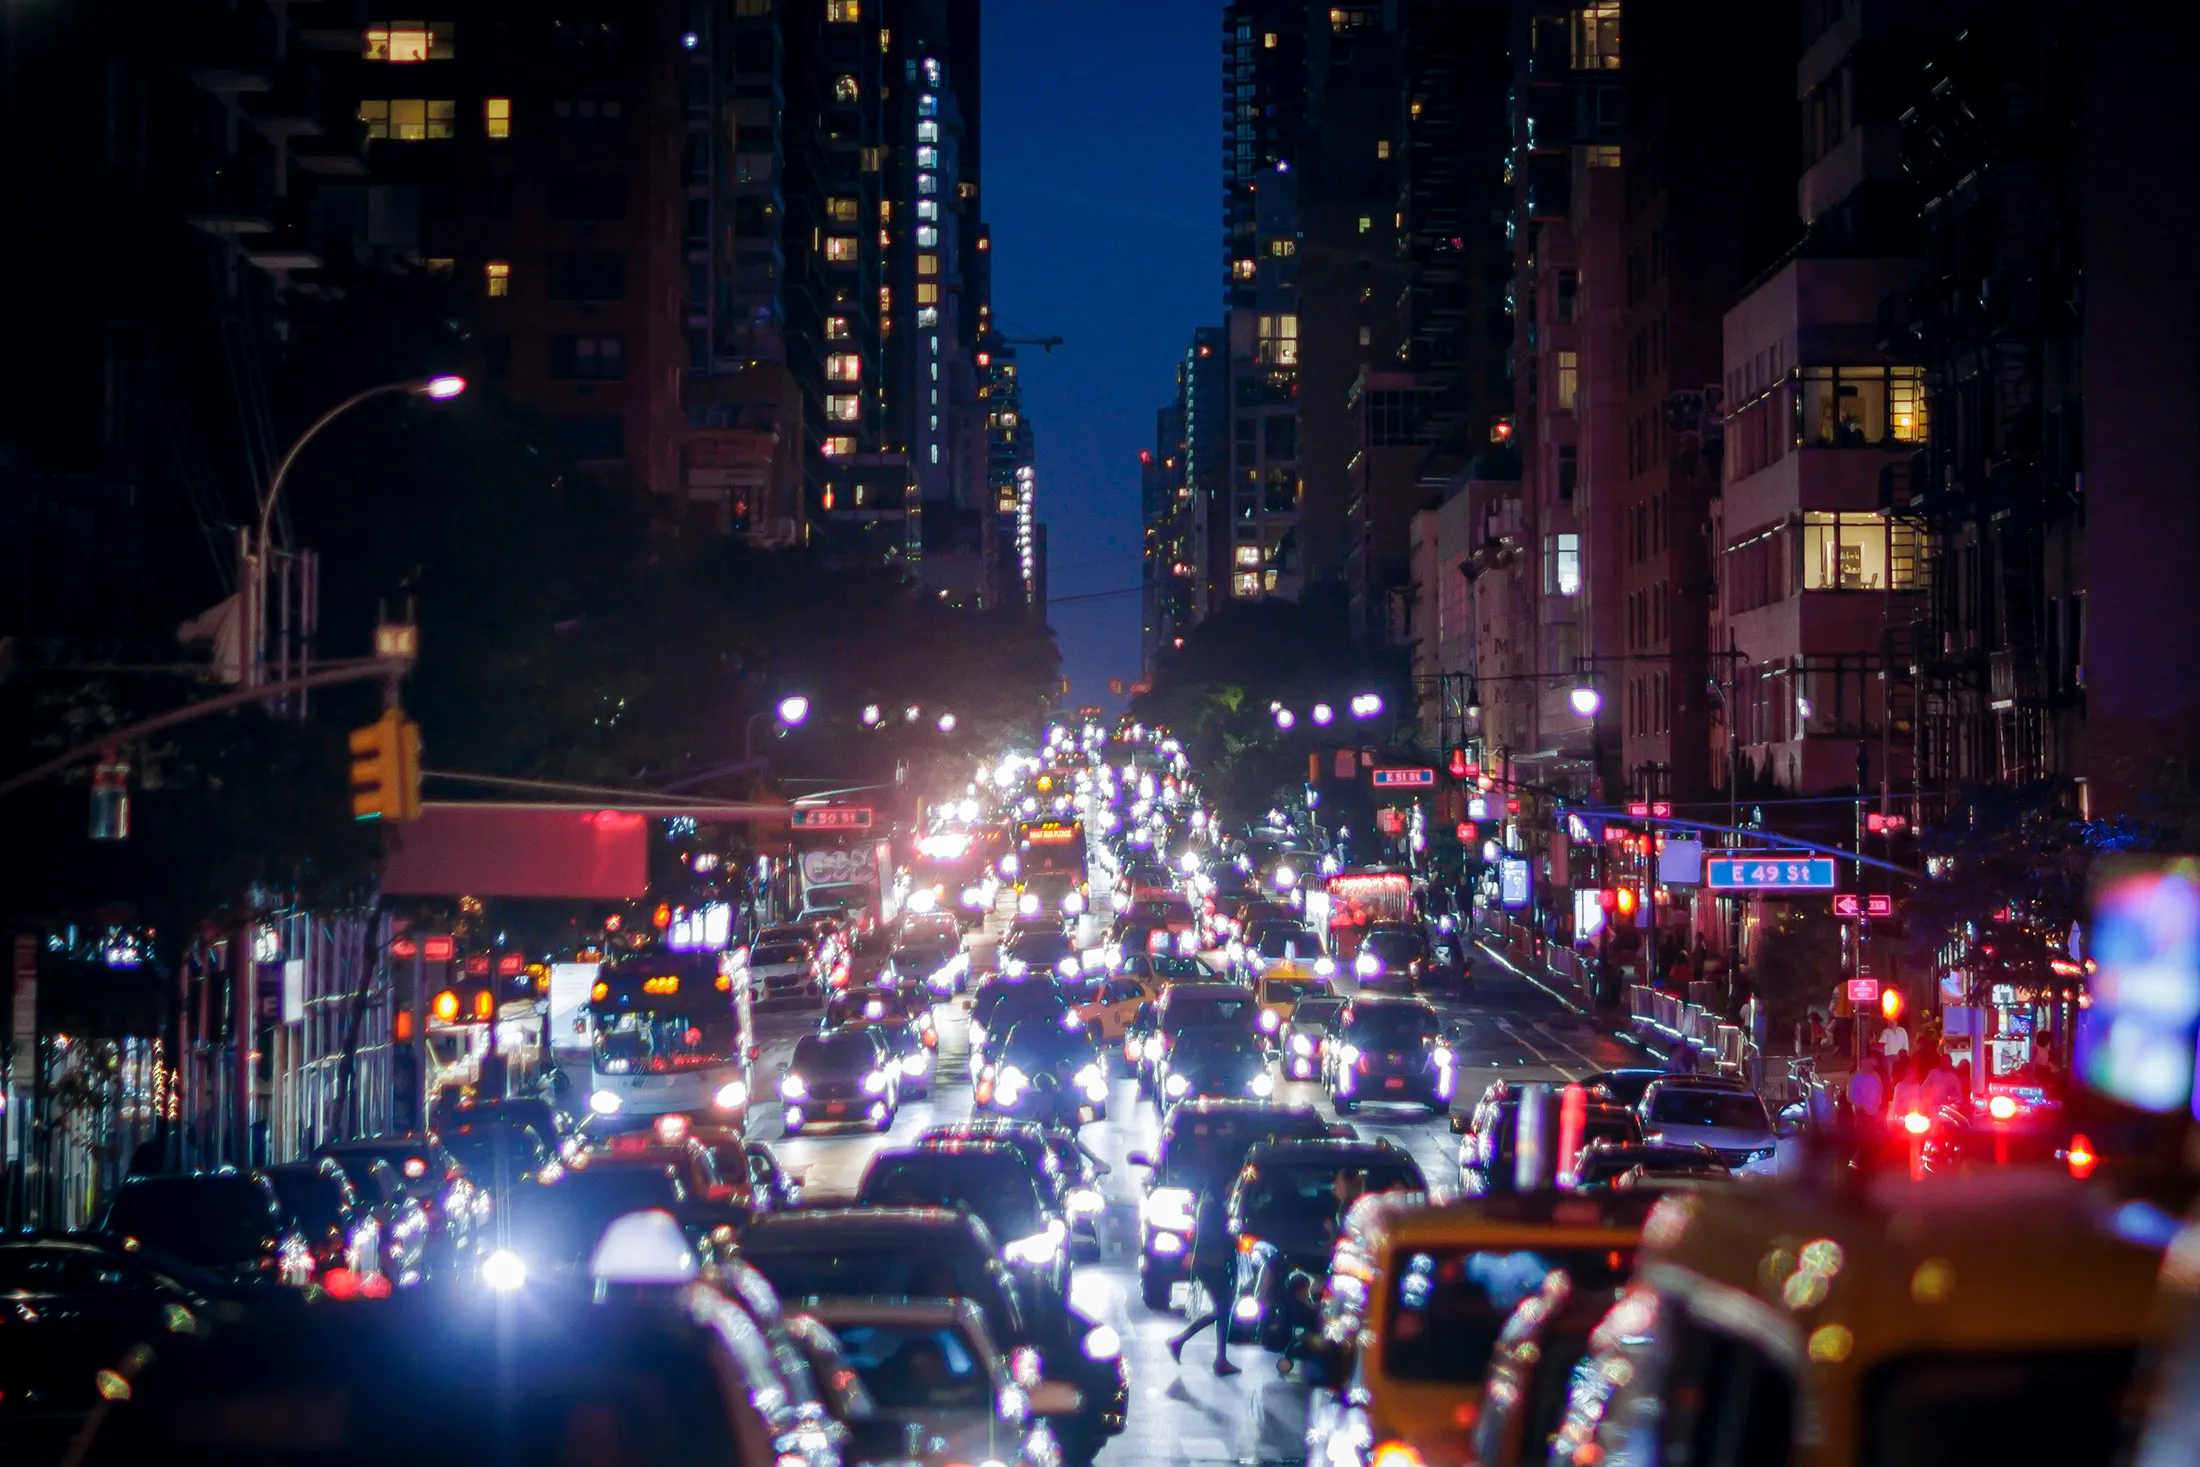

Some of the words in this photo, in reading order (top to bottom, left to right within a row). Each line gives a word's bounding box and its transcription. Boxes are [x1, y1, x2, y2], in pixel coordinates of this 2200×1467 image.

[1386, 772, 1393, 782] E
[1395, 772, 1407, 782] 51
[1409, 772, 1420, 782] St
[818, 812, 837, 825] 50
[1732, 865, 1744, 881] E
[1751, 865, 1778, 881] 49
[1787, 865, 1809, 881] St
